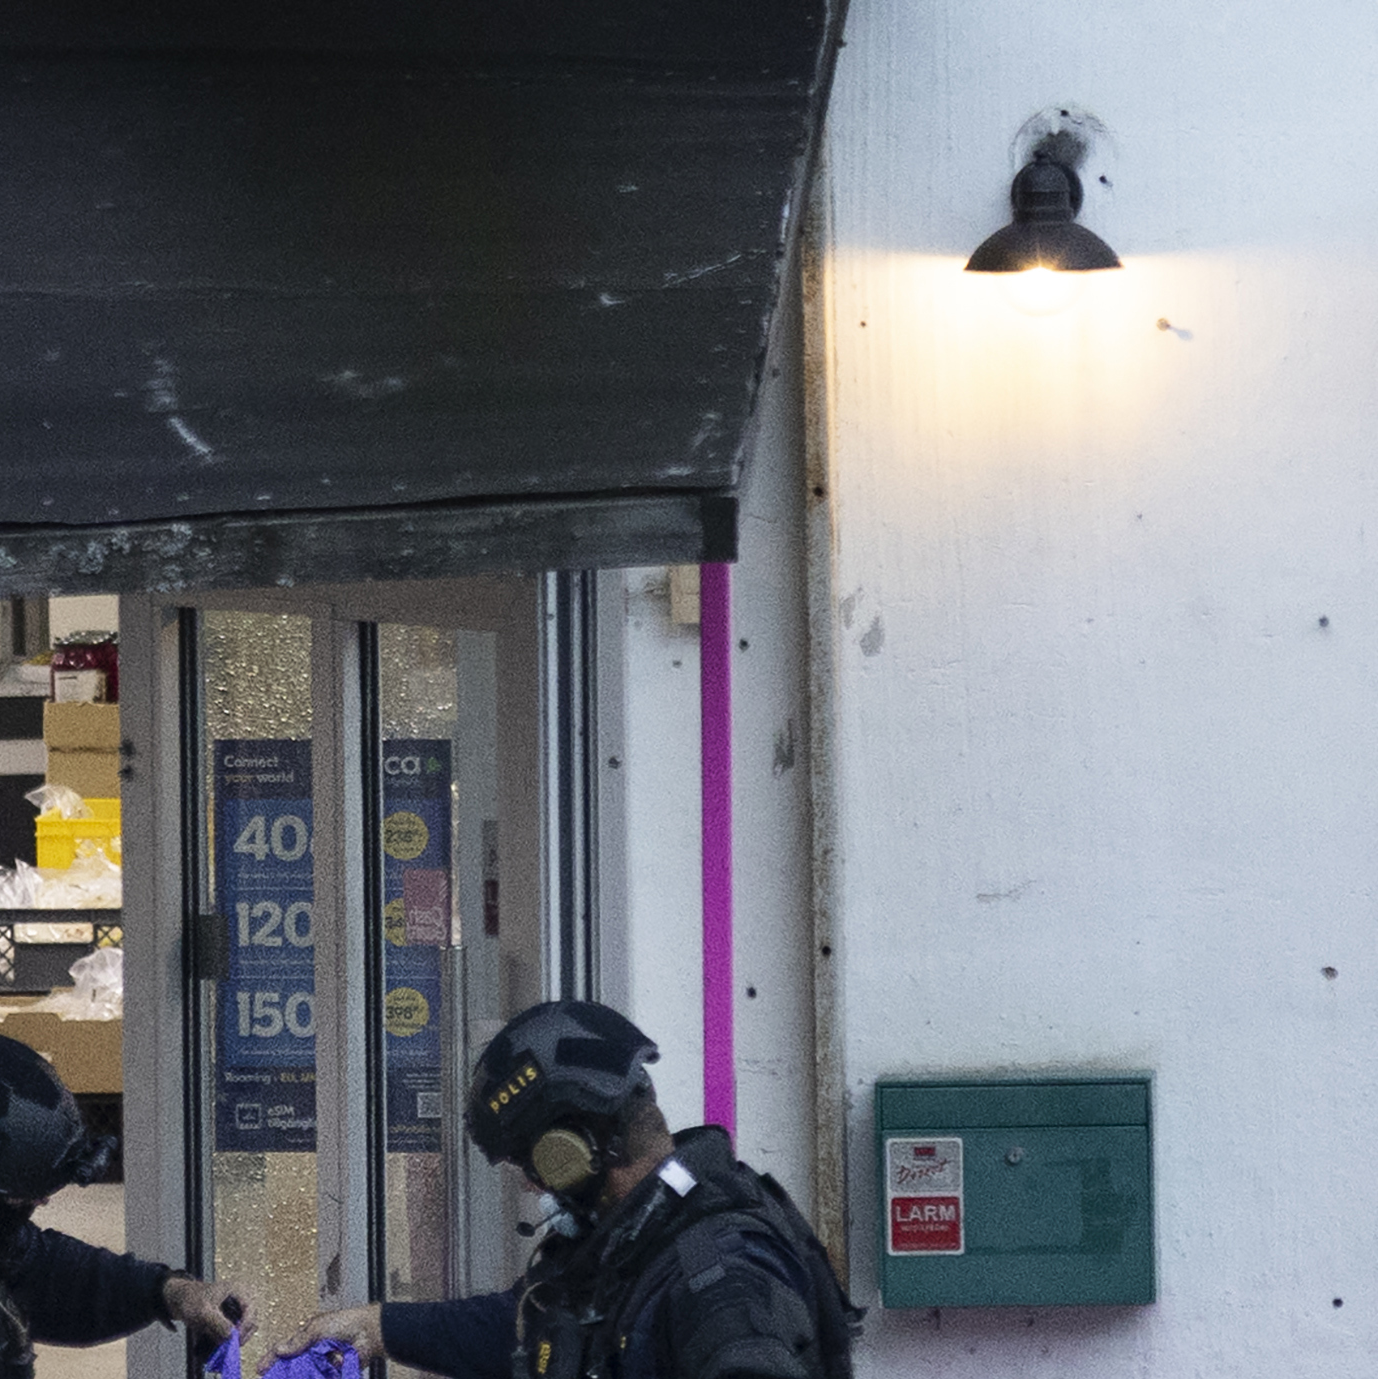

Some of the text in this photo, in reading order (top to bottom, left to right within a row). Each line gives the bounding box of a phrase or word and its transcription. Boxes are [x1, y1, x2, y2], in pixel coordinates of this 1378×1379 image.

[223, 755, 279, 769] Connect
[257, 770, 295, 784] world
[233, 815, 314, 862] 40
[490, 1067, 537, 1114] POLIS
[896, 1204, 956, 1222] LARM
